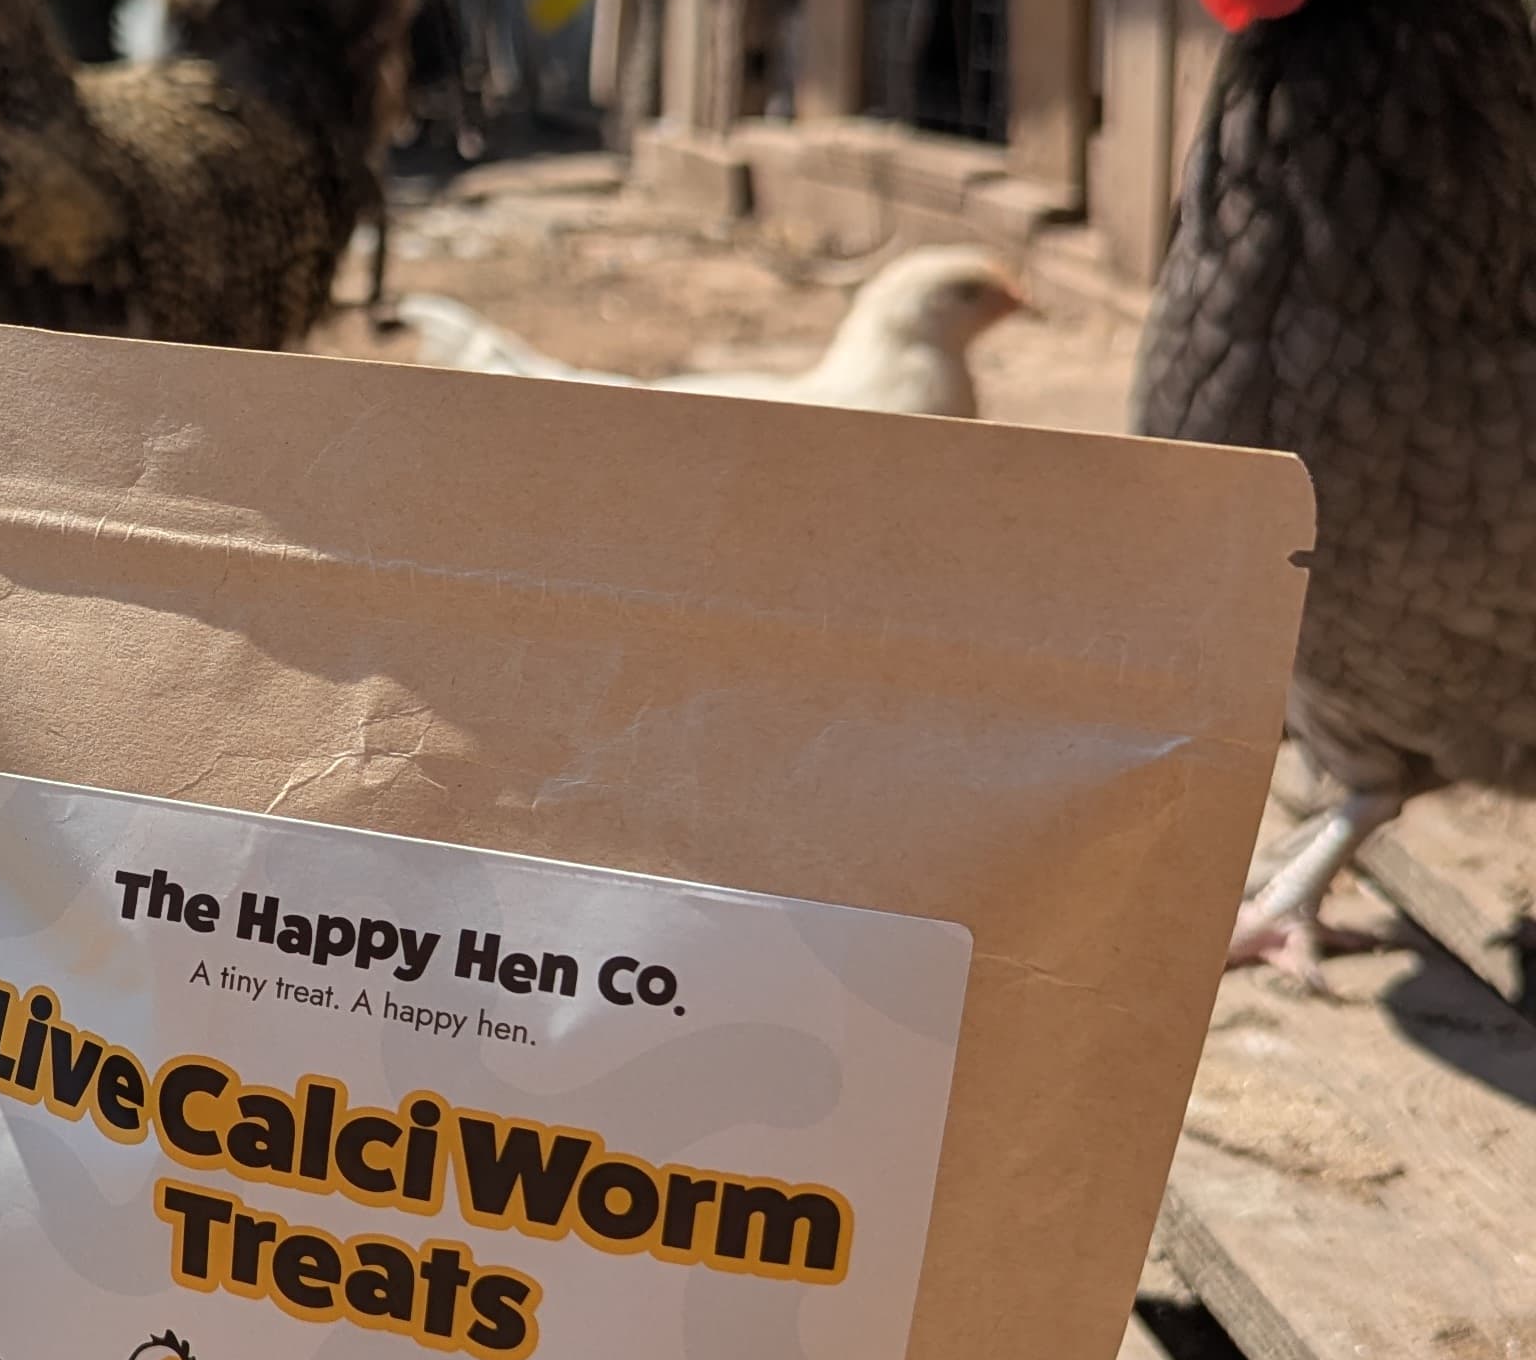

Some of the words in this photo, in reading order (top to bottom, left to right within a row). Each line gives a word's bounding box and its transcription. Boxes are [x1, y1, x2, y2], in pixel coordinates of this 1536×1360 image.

[115, 869, 221, 934] The
[235, 891, 442, 982] Happy
[454, 928, 579, 998] Hen
[597, 955, 686, 1017] Co.
[189, 959, 211, 987] A
[220, 965, 268, 1002] tiny
[275, 976, 340, 1011] treat.
[350, 988, 373, 1017] A
[382, 990, 469, 1039] happy
[476, 1007, 537, 1047] hen.
[154, 1061, 444, 1205] Calci
[455, 1113, 844, 1272] Worm
[159, 1183, 534, 1354] Treats
